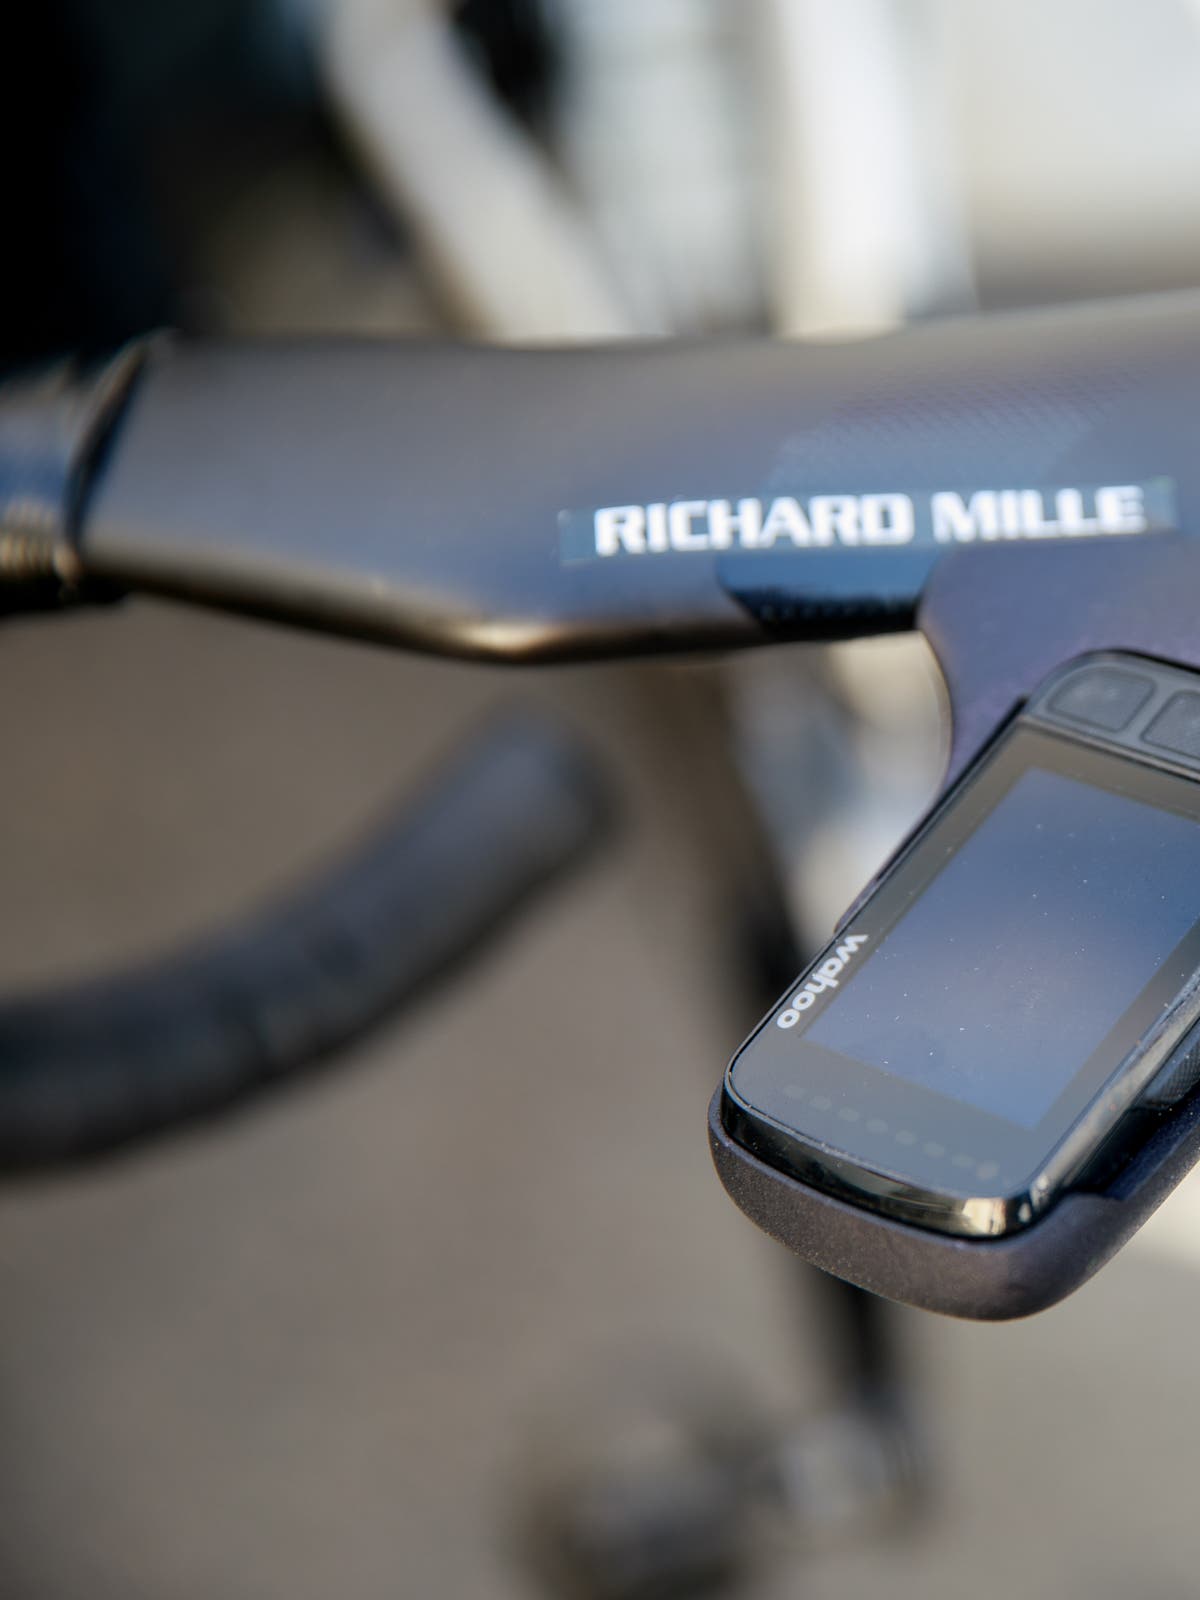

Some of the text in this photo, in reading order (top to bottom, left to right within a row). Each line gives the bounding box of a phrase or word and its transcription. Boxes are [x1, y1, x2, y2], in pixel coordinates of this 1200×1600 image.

[594, 486, 1144, 556] RICHARD MILLE
[776, 934, 869, 1029] wahoo
